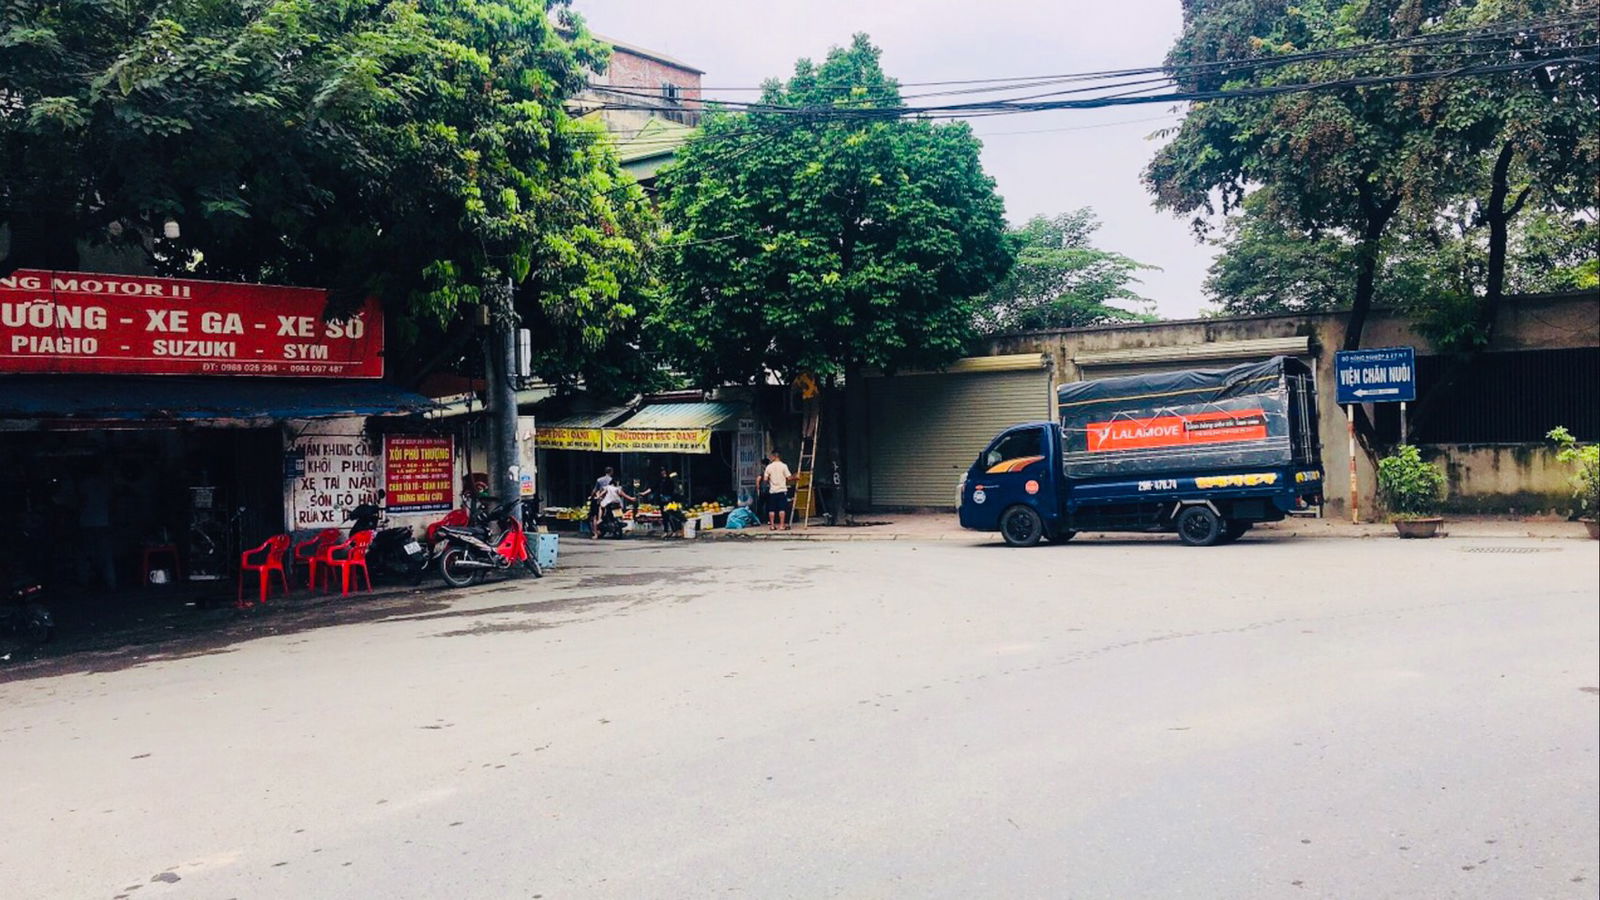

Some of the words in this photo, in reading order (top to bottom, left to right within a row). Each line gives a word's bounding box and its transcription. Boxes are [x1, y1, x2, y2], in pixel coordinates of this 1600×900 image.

[53, 278, 163, 296] MOTOR
[145, 309, 189, 333] XE
[201, 311, 244, 335] GA
[277, 315, 316, 338] XE
[11, 335, 98, 354] PIAGIO
[152, 339, 236, 357] SUZUKI
[283, 343, 329, 360] SYM
[1340, 366, 1360, 387] VIỆN
[1362, 364, 1386, 384] CHĂN
[1388, 362, 1411, 383] NUÔI
[1112, 424, 1179, 440] LALAMOVE
[323, 443, 353, 456] KHUNG
[308, 457, 331, 473] KHÔI
[301, 477, 316, 491] XE
[320, 510, 335, 522] XE
